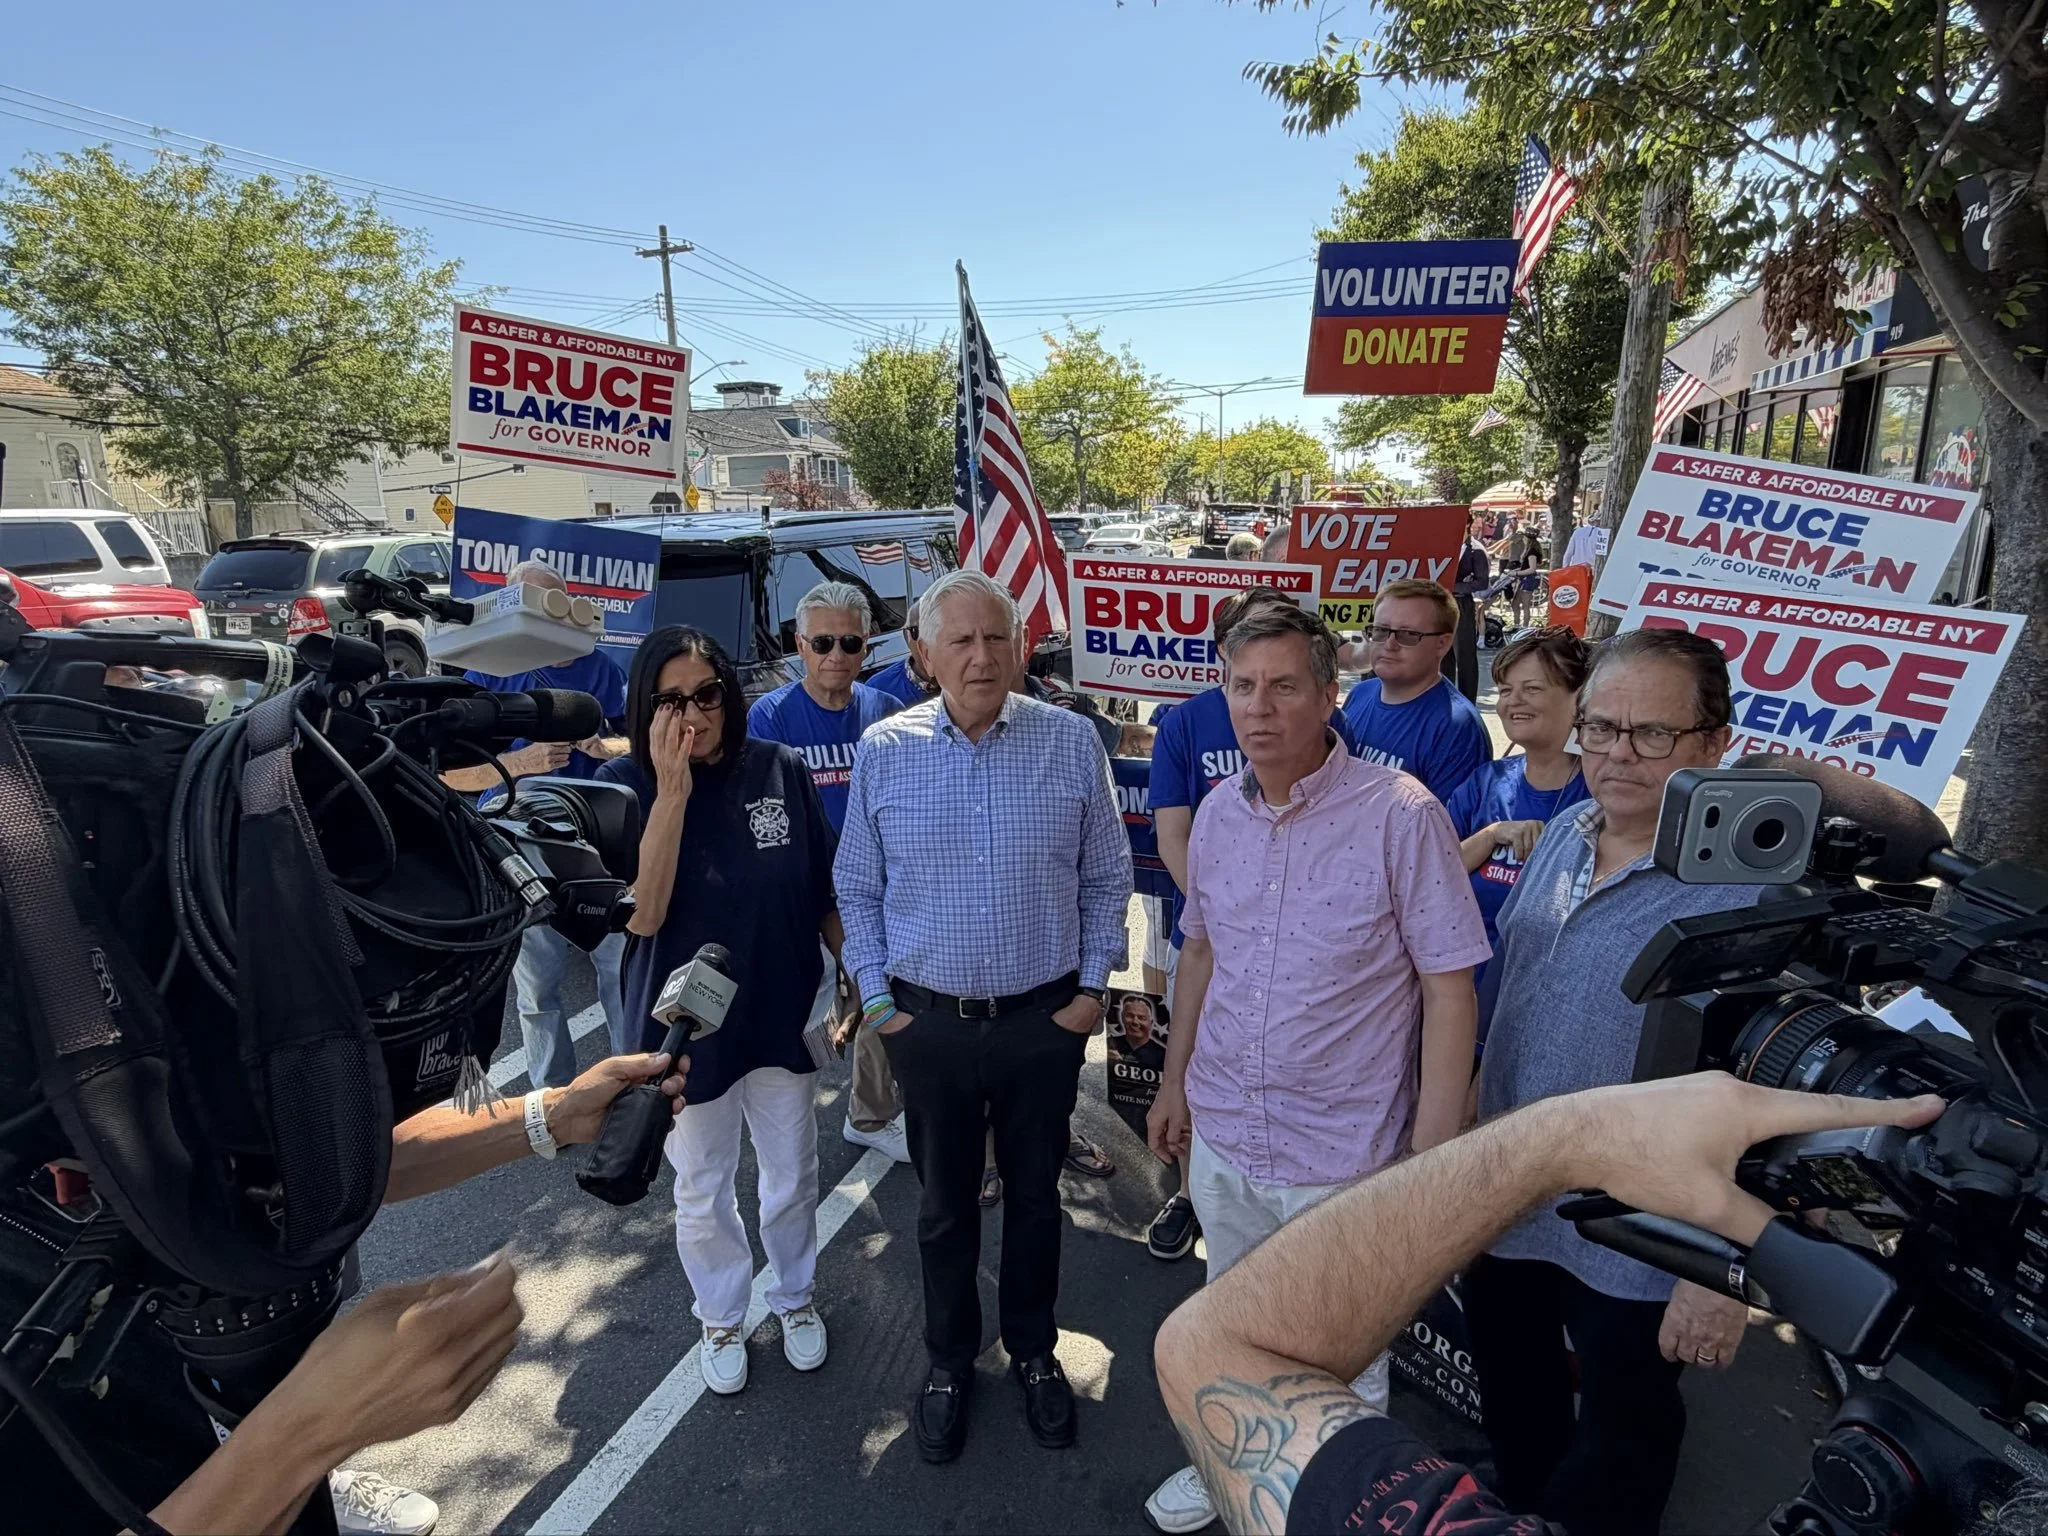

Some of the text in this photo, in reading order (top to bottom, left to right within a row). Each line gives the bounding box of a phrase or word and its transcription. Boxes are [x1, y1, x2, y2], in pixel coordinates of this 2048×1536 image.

[1962, 202, 1989, 232] The
[1321, 265, 1511, 307] VOLUNTEER
[471, 319, 677, 367] A SAFER & AFFORDABLE NY
[1342, 327, 1469, 365] DONATE
[469, 340, 675, 416] BRUCE
[468, 386, 672, 442] BLAKEMAN
[489, 418, 524, 440] for
[527, 425, 651, 458] GOVERNOR
[1672, 460, 1935, 514] A SAFER & AFFORDABLE NY
[1301, 513, 1397, 550] VOTE
[1697, 488, 1870, 548] BRUCE
[457, 538, 519, 573] TOM
[1637, 510, 1918, 594] BLAKEMAN
[1083, 566, 1301, 588] A SAFER & AFFORDABLE NY
[1692, 552, 1719, 567] for
[1720, 559, 1821, 591] GOVERNOR
[577, 596, 635, 614] SEMBLY
[1083, 587, 1222, 635] BRU
[1653, 589, 1986, 645] A SAFER & AFFORDABLE NY
[1085, 629, 1222, 664] BLAKE
[1106, 658, 1226, 684] for GOVER
[1730, 690, 1938, 768] KEMAN
[794, 742, 860, 770] SULLIV
[813, 772, 838, 785] STATE
[1703, 789, 1734, 798] SmallRig
[1116, 786, 1151, 814] OM
[1486, 865, 1516, 882] STATE
[577, 903, 607, 916] Canon
[689, 983, 725, 1009] NEW YORK
[1114, 1063, 1163, 1082] GEO
[1114, 1094, 1135, 1104] VOTE
[1412, 1352, 1430, 1367] for
[1413, 1321, 1479, 1382] ORG
[1396, 1357, 1420, 1380] NOV.
[1436, 1386, 1459, 1407] FOR
[1461, 1405, 1468, 1414] A
